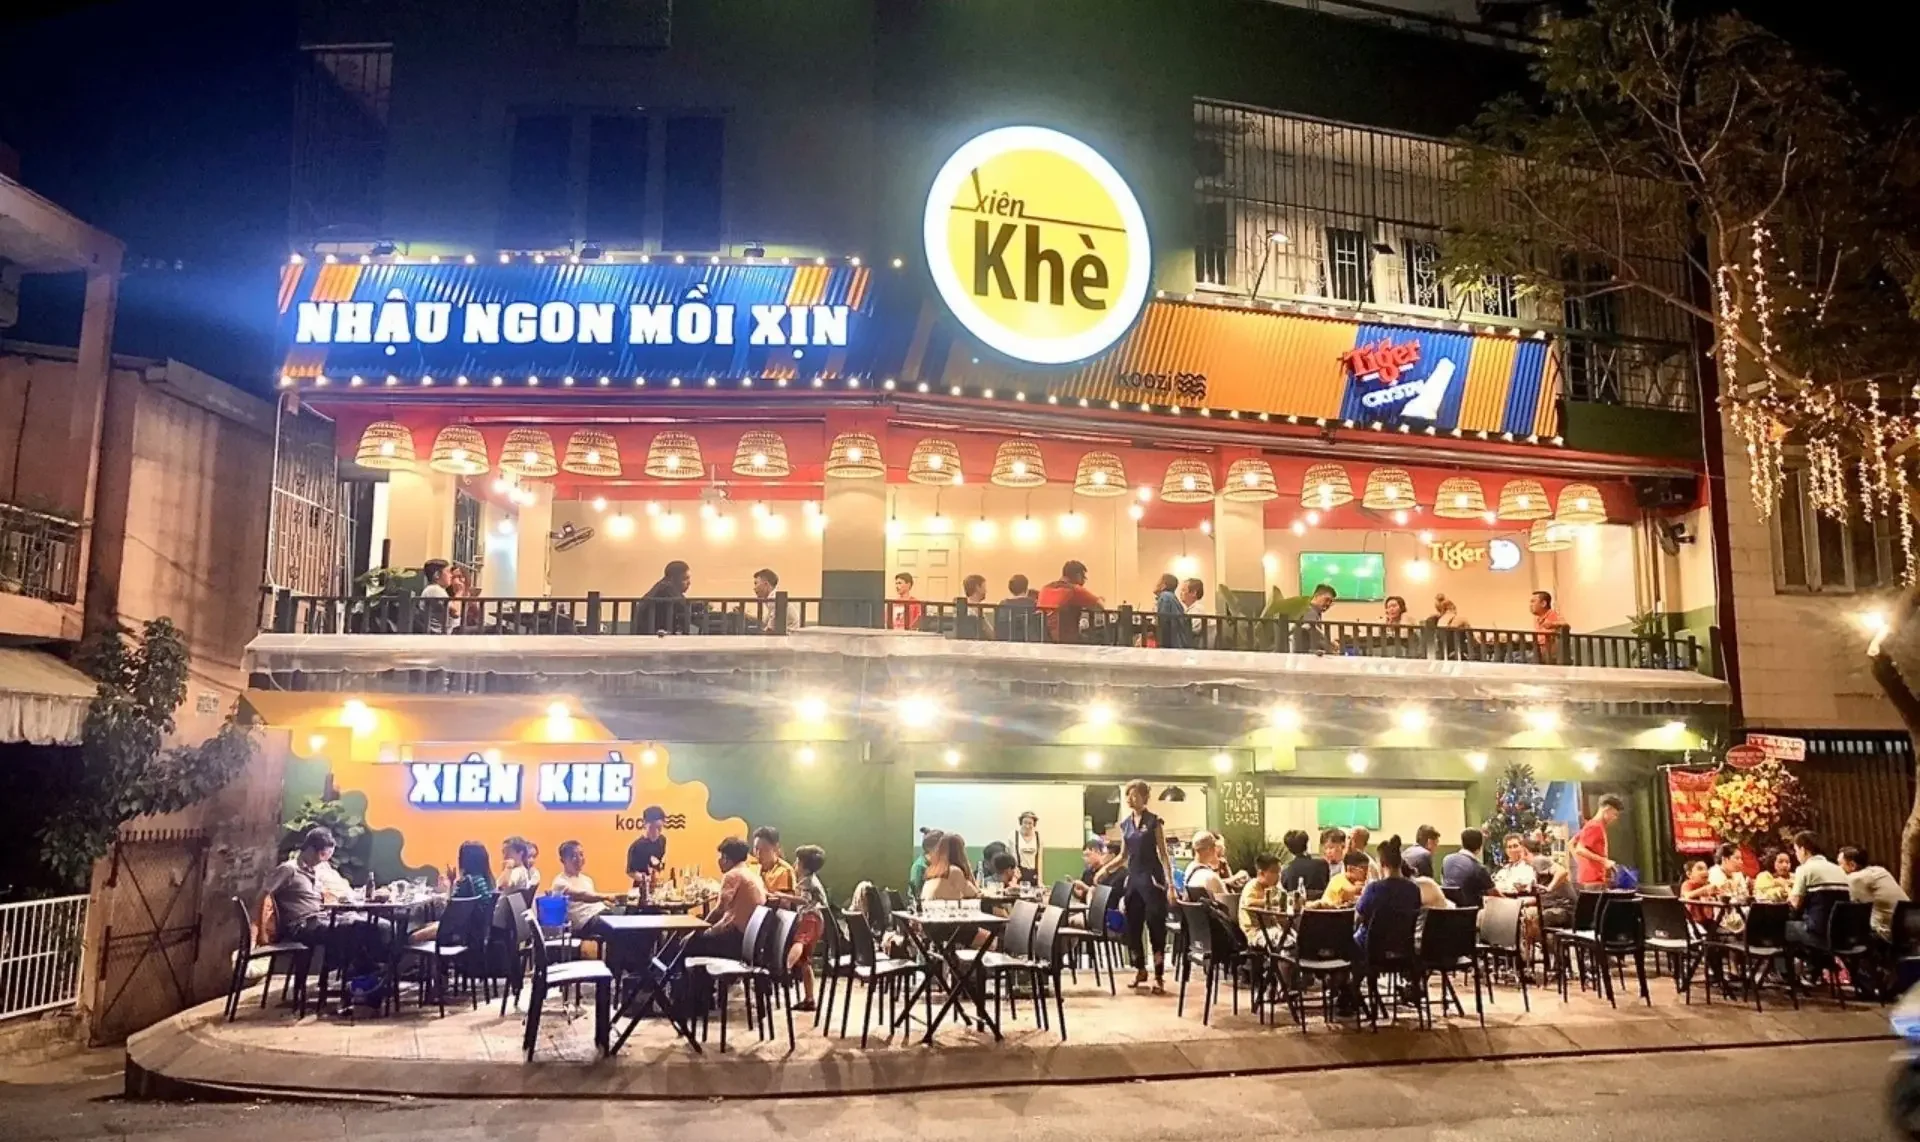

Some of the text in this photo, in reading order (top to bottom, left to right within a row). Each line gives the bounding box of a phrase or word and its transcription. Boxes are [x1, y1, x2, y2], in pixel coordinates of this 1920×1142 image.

[972, 177, 1025, 218] xiên
[974, 219, 1109, 311] Khè
[296, 283, 849, 358] NHẬU NGON MỒI XỊN
[1344, 339, 1420, 384] Tiger
[1428, 541, 1486, 571] Tiger
[409, 751, 633, 806] XIÊN KHÈ
